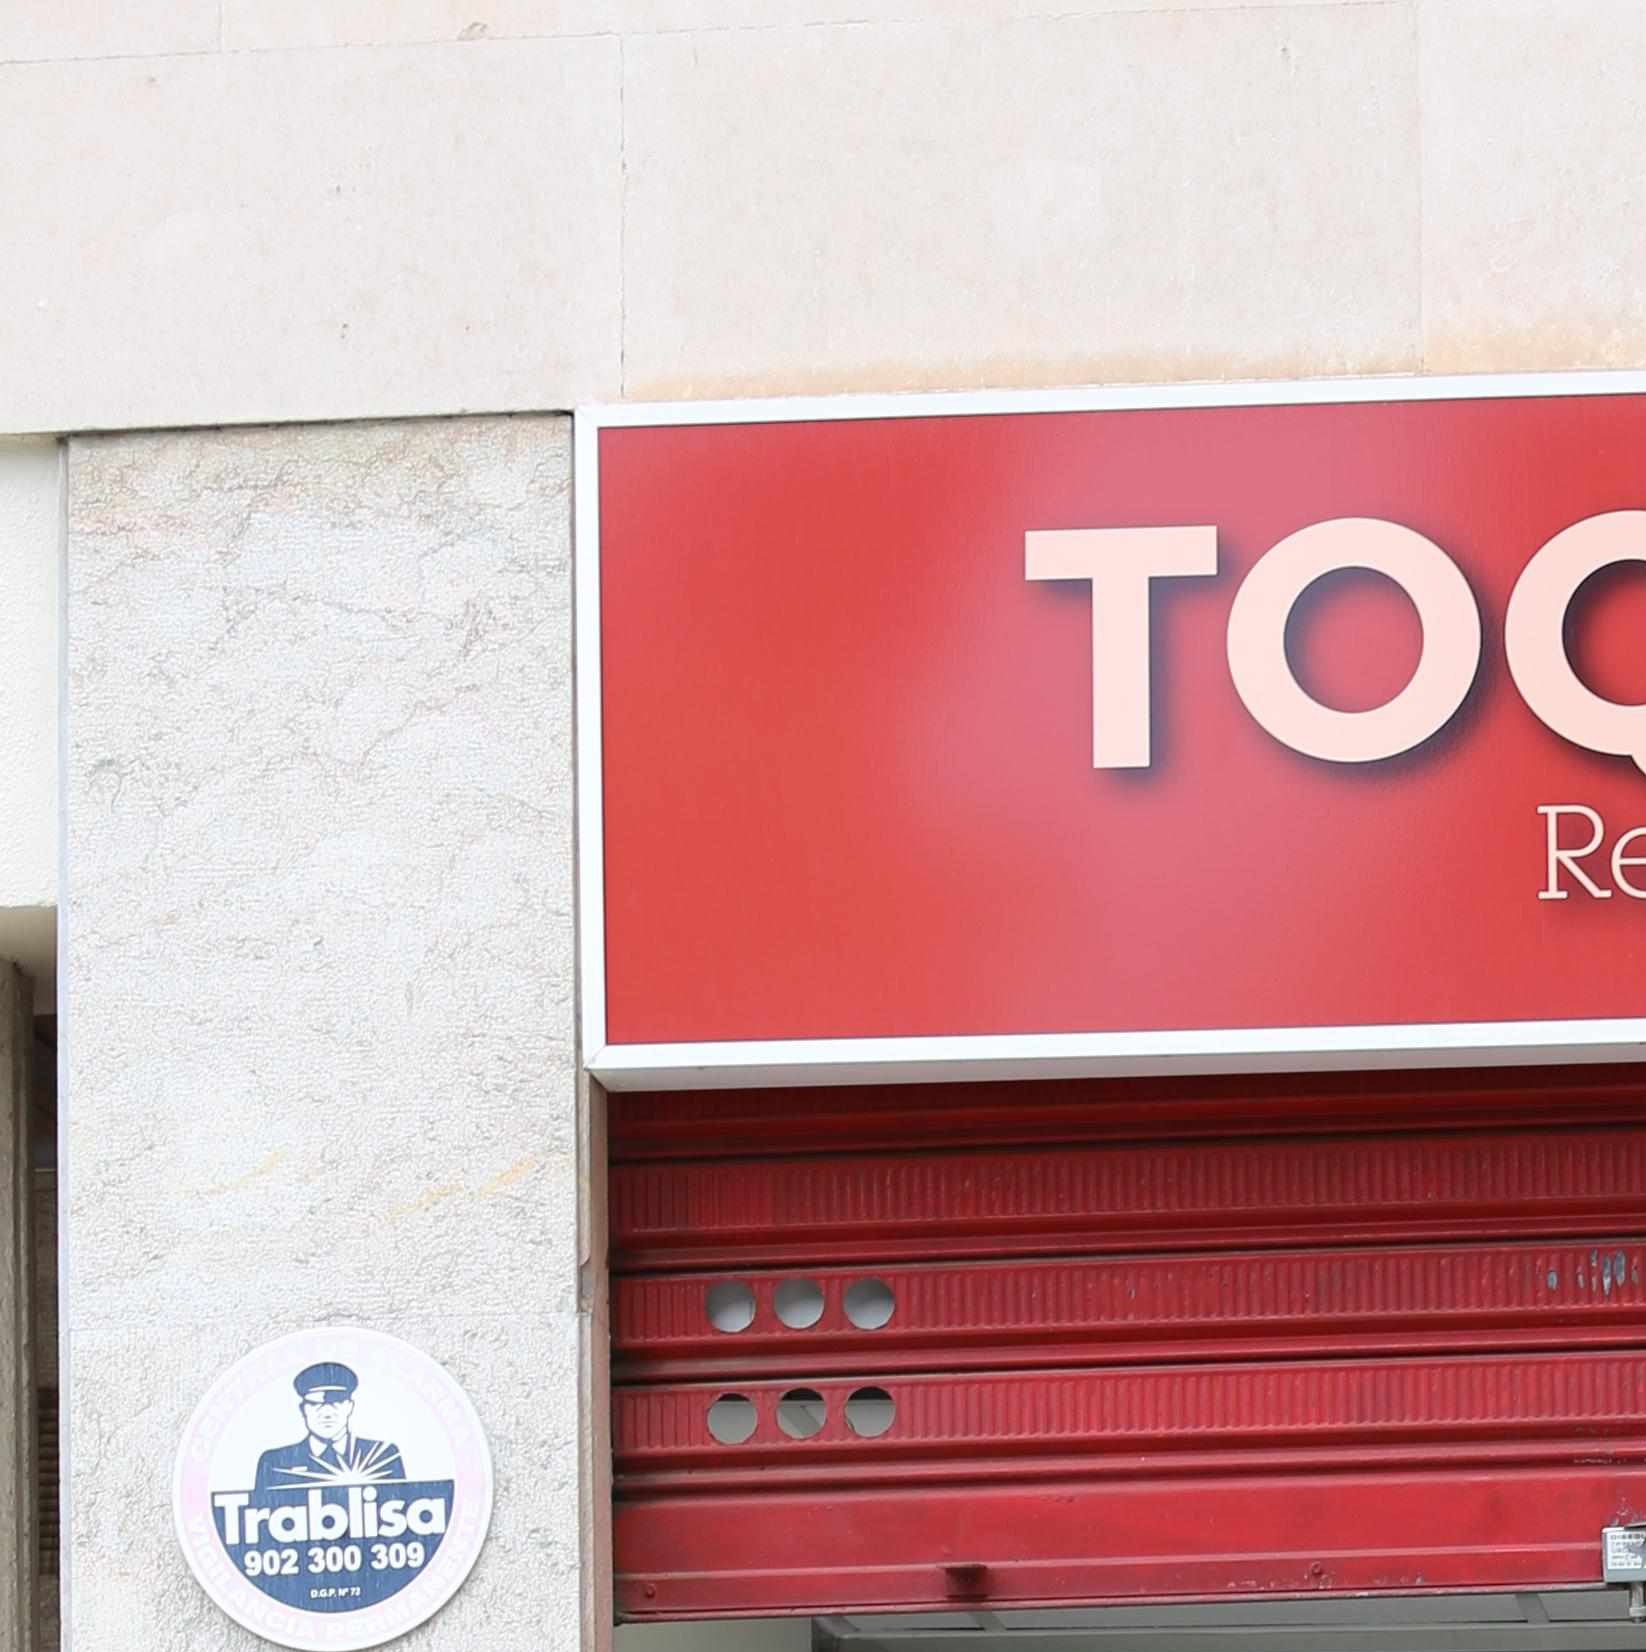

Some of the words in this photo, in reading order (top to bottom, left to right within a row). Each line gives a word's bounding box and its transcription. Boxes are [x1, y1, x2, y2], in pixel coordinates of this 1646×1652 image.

[213, 1486, 446, 1545] Trablisa
[244, 1548, 300, 1577] 902
[307, 1545, 362, 1574] 300
[370, 1541, 425, 1570] 309
